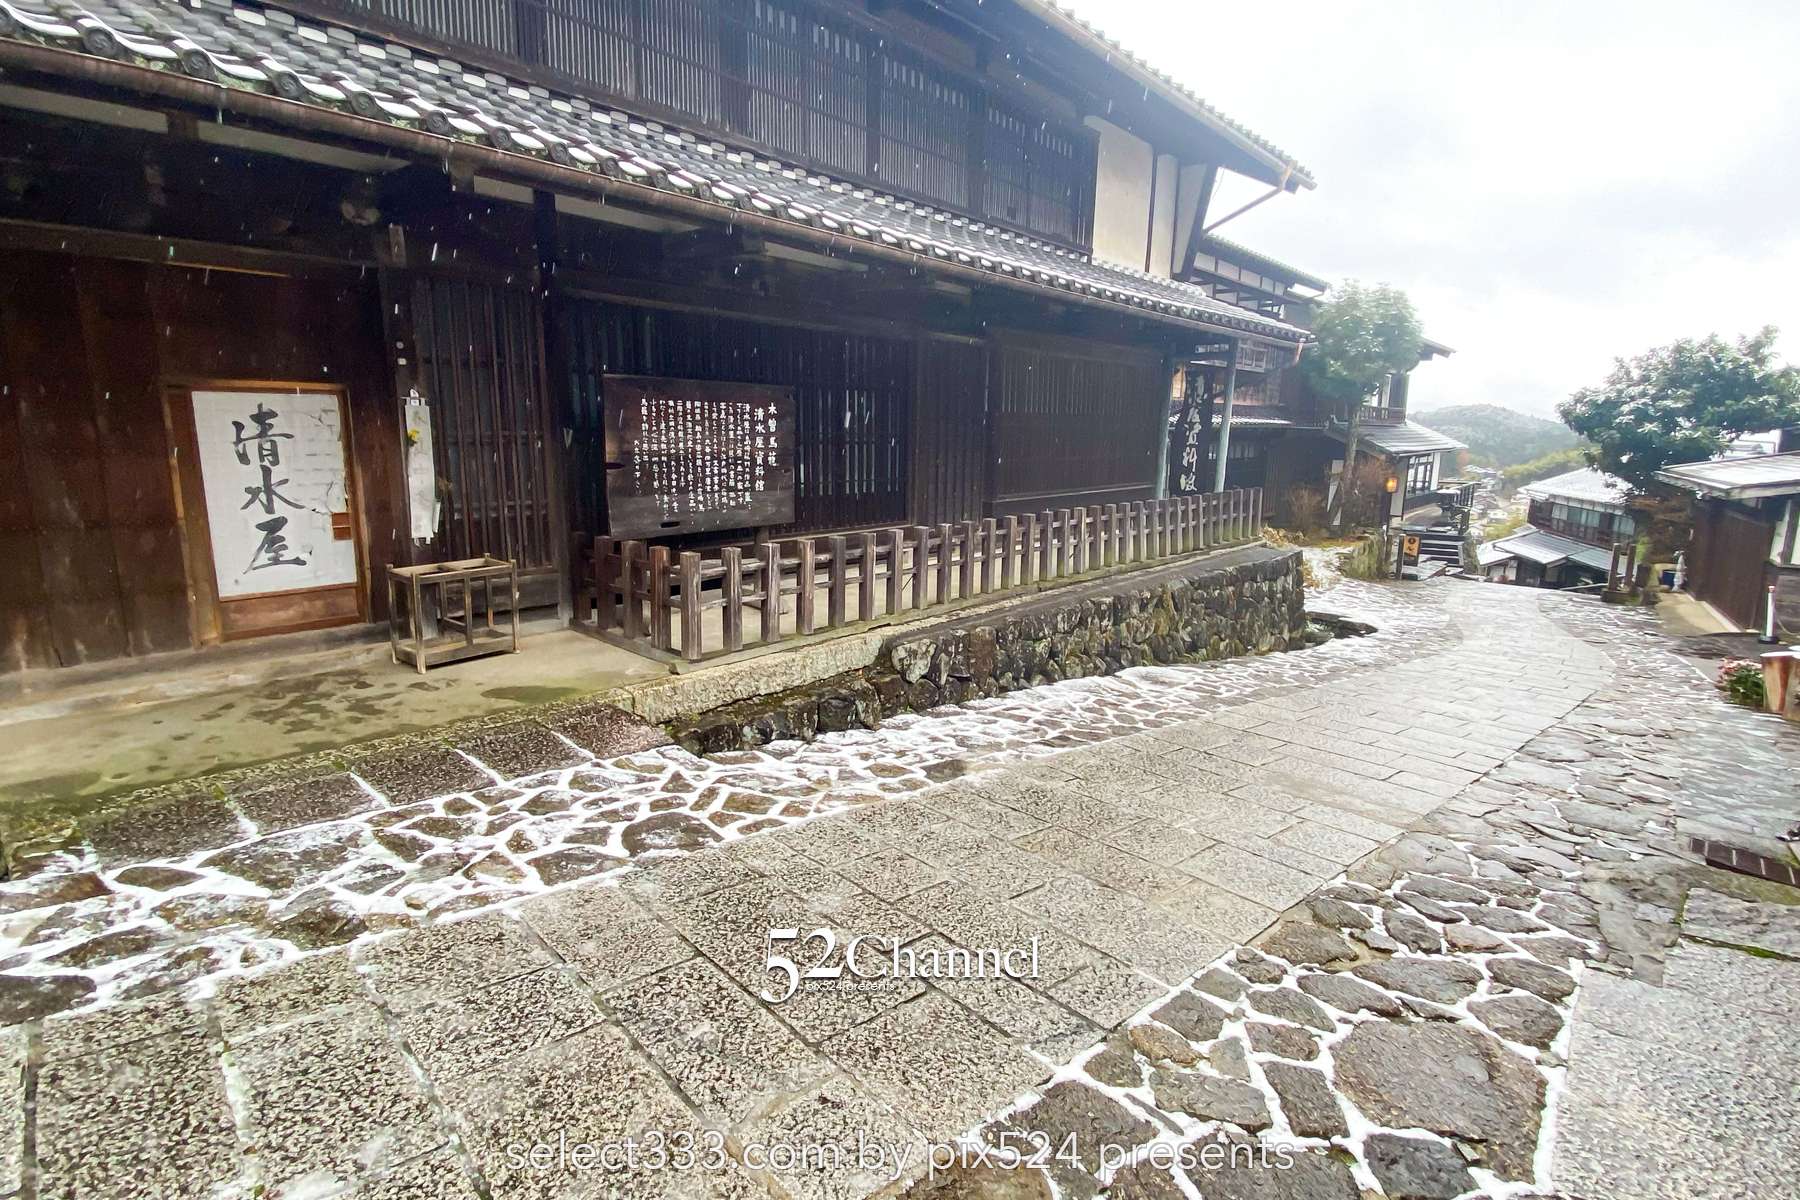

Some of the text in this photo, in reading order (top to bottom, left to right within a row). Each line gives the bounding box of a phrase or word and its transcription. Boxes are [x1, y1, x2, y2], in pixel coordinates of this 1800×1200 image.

[231, 402, 307, 574] 清水屋
[754, 408, 765, 492] 清水屋資料館
